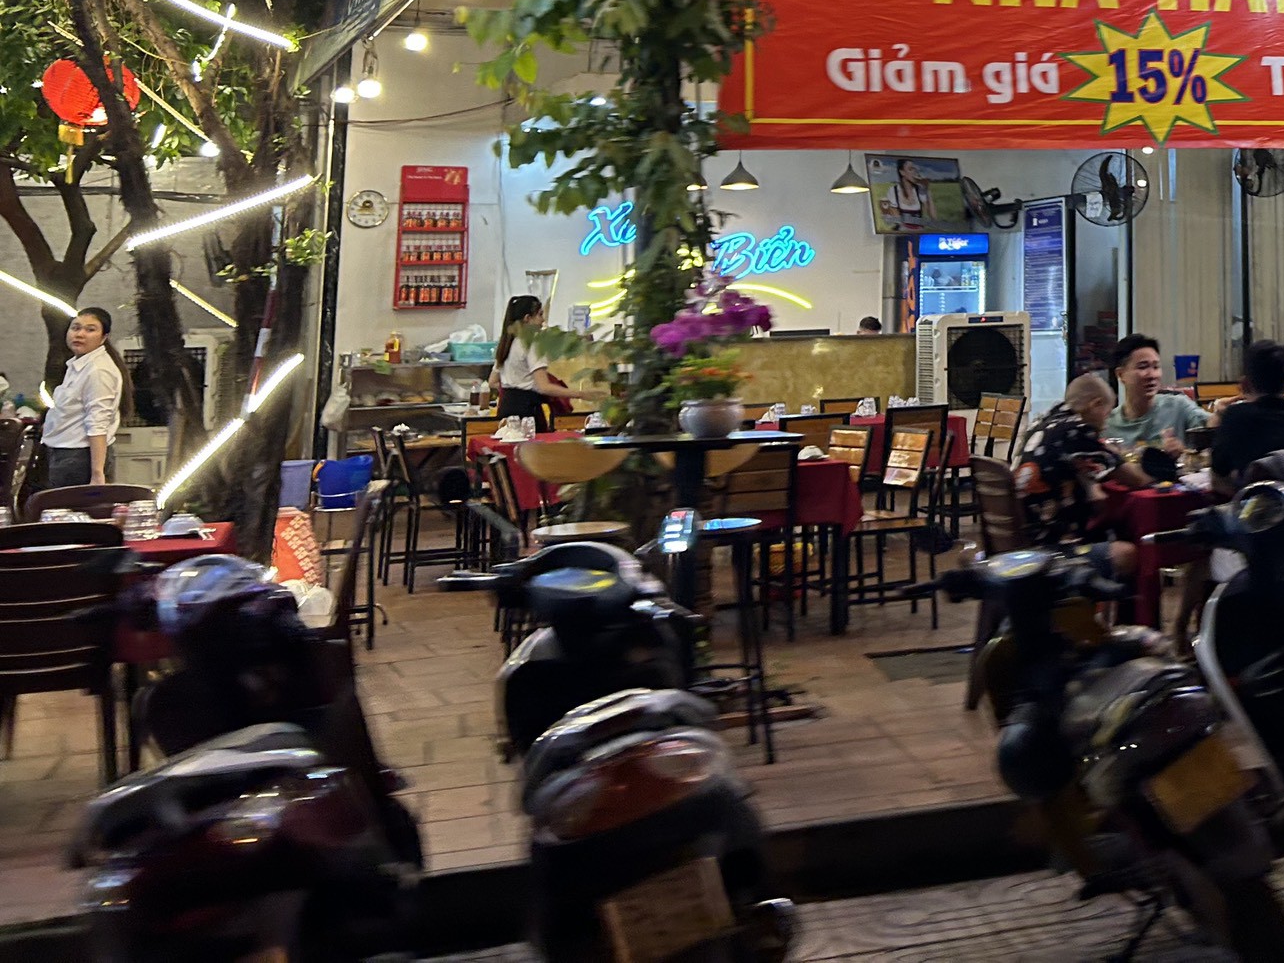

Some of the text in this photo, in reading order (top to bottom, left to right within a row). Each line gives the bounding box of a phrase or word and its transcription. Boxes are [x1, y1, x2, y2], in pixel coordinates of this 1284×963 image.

[826, 42, 972, 95] Giảm
[982, 50, 1062, 104] giá
[1108, 46, 1207, 106] 15%
[710, 224, 817, 281] Biển
